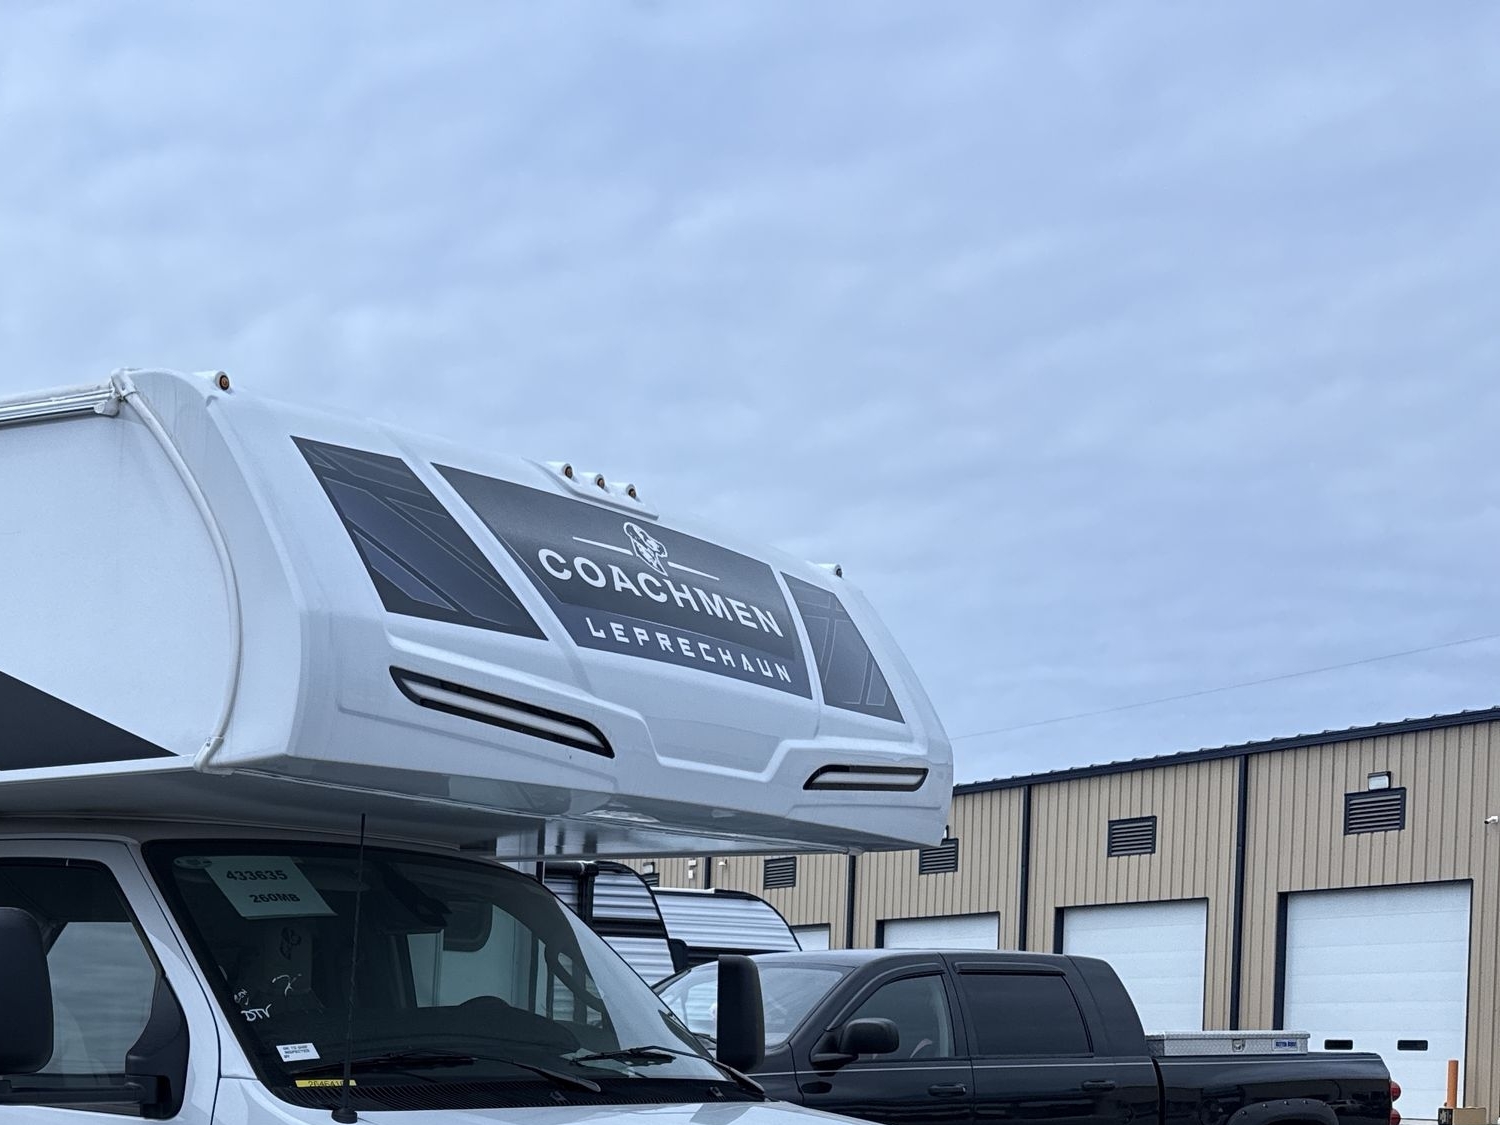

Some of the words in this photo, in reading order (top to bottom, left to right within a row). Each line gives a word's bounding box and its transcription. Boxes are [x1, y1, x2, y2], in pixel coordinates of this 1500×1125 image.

[537, 548, 785, 638] COACHMEN
[585, 616, 792, 684] LEPRECHAUN
[226, 869, 289, 881] 433635
[249, 892, 301, 904] 260MB
